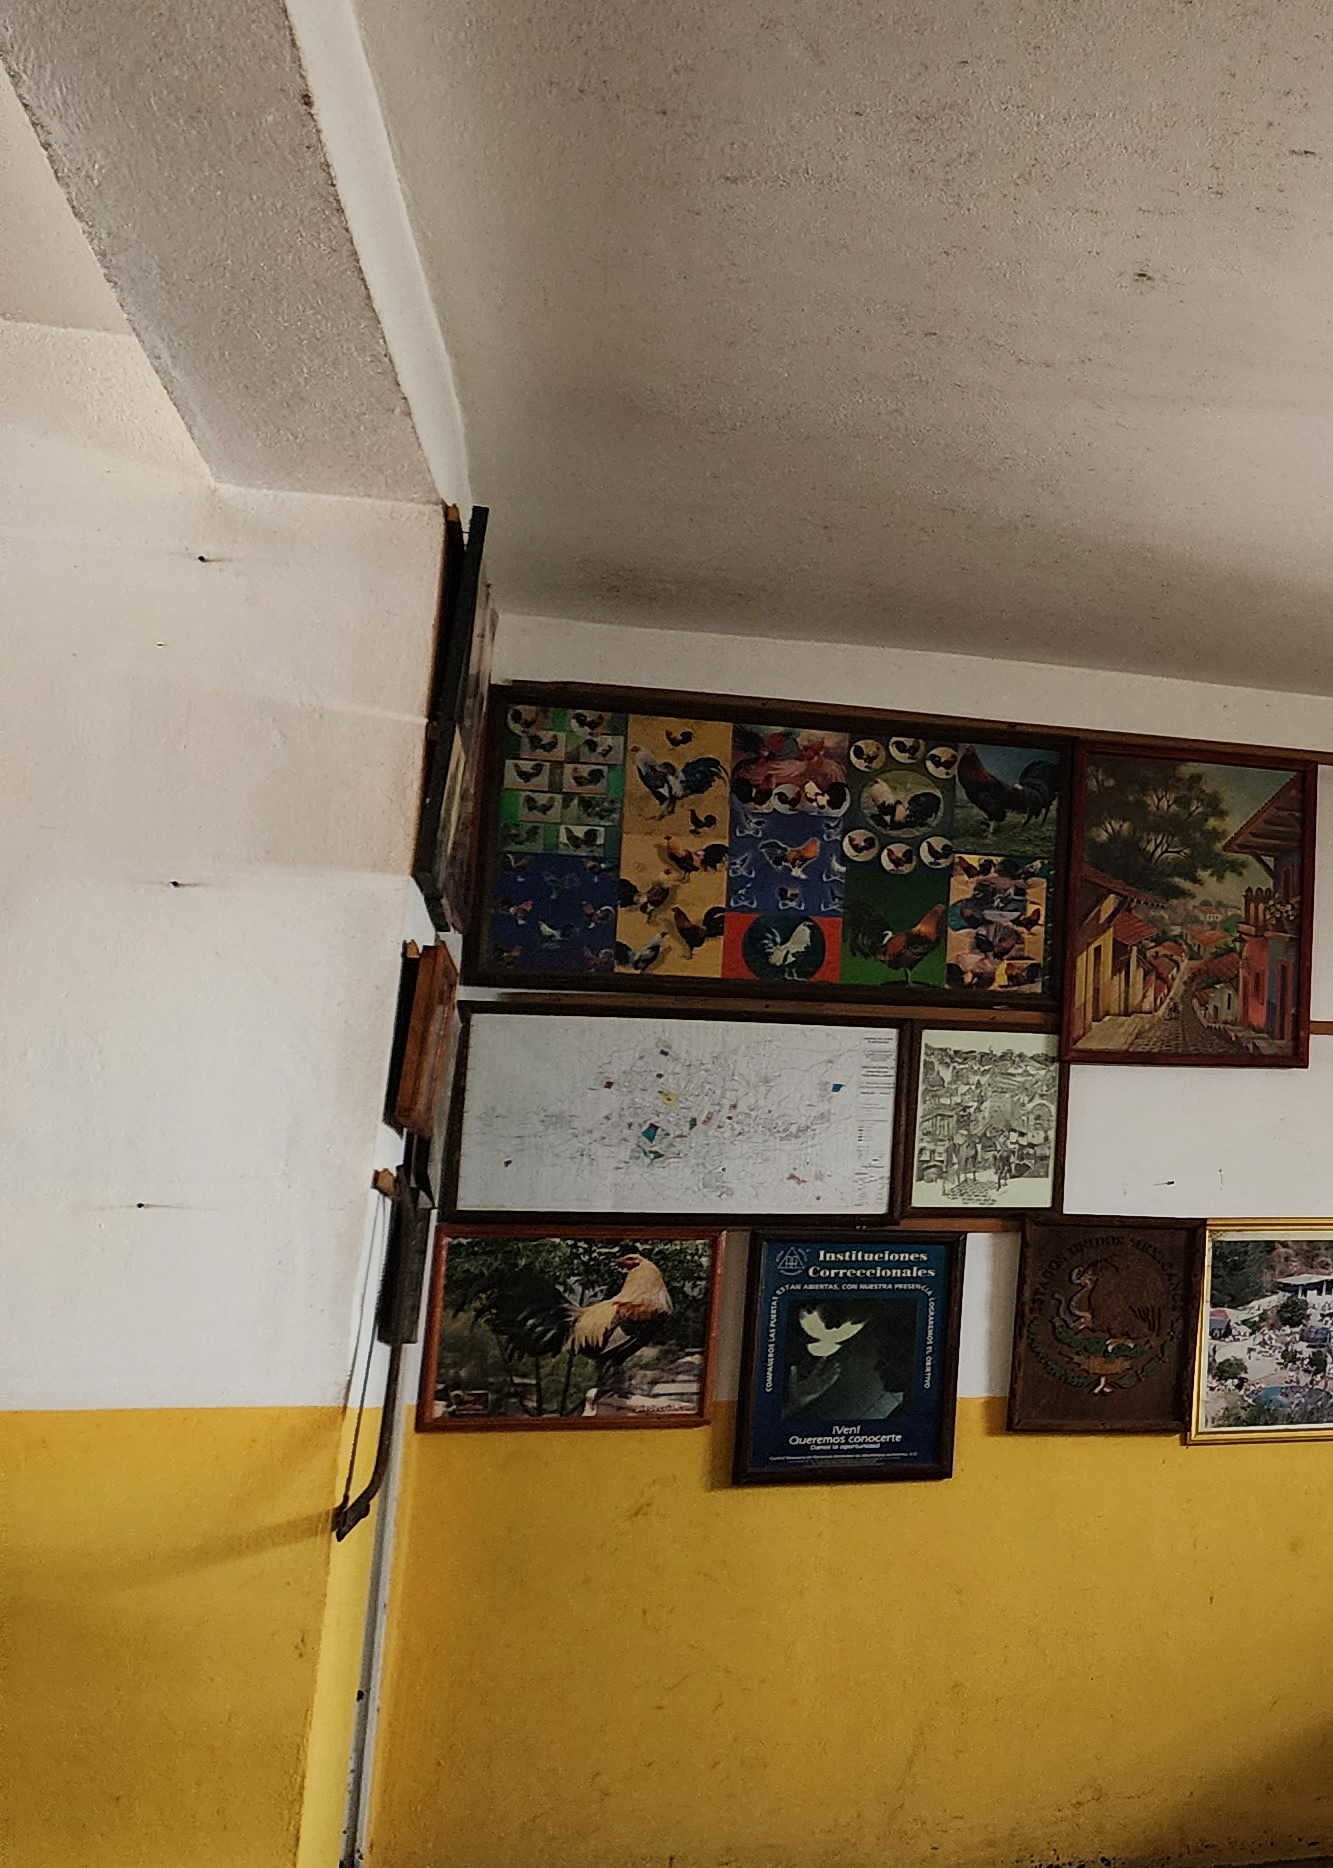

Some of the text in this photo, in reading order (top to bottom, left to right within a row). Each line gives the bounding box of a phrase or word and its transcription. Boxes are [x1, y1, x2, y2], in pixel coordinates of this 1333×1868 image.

[818, 1250, 928, 1262] Instituciones
[808, 1265, 936, 1278] Correccionales
[768, 1328, 776, 1342] LAS
[894, 1283, 933, 1297] PRESENCIA
[789, 1434, 903, 1445] Queremos conocerte
